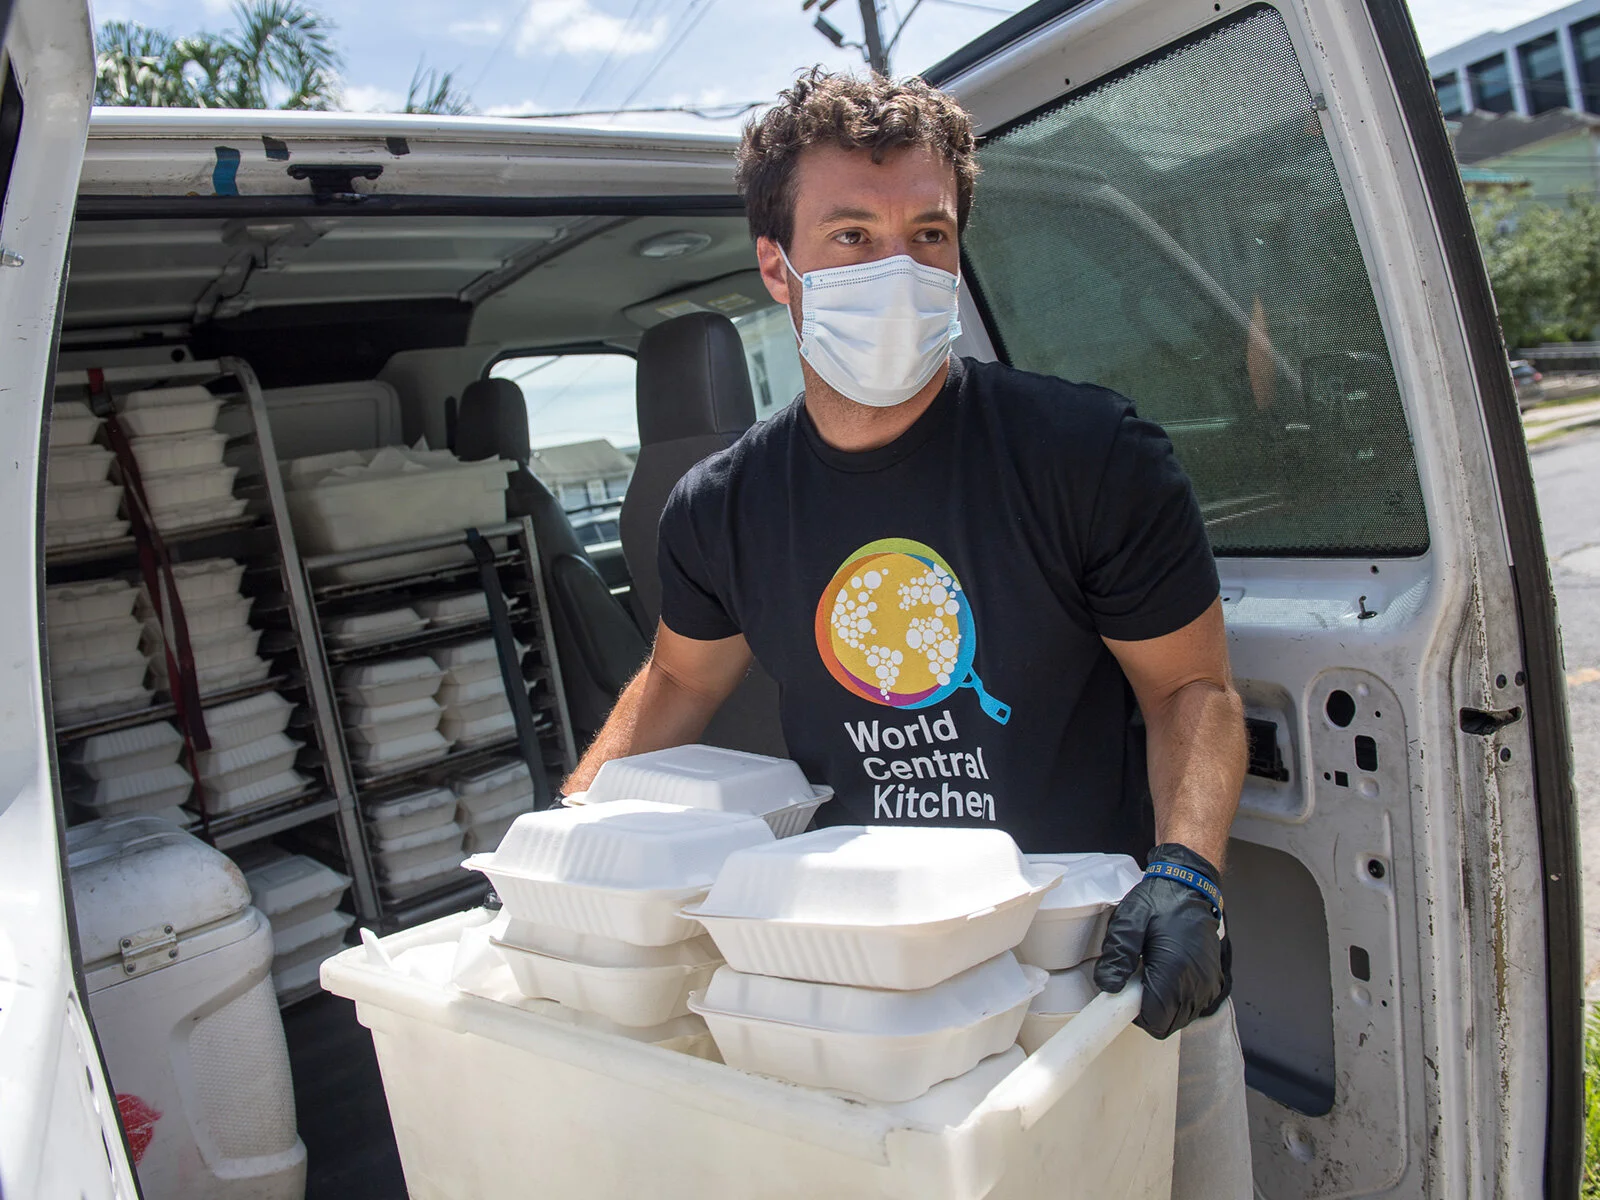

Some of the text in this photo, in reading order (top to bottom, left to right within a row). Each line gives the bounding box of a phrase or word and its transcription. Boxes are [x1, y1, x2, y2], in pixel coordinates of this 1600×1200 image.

[844, 710, 958, 752] World
[863, 747, 989, 780] Central
[874, 782, 996, 821] Kitchen
[1165, 865, 1195, 882] EDGE
